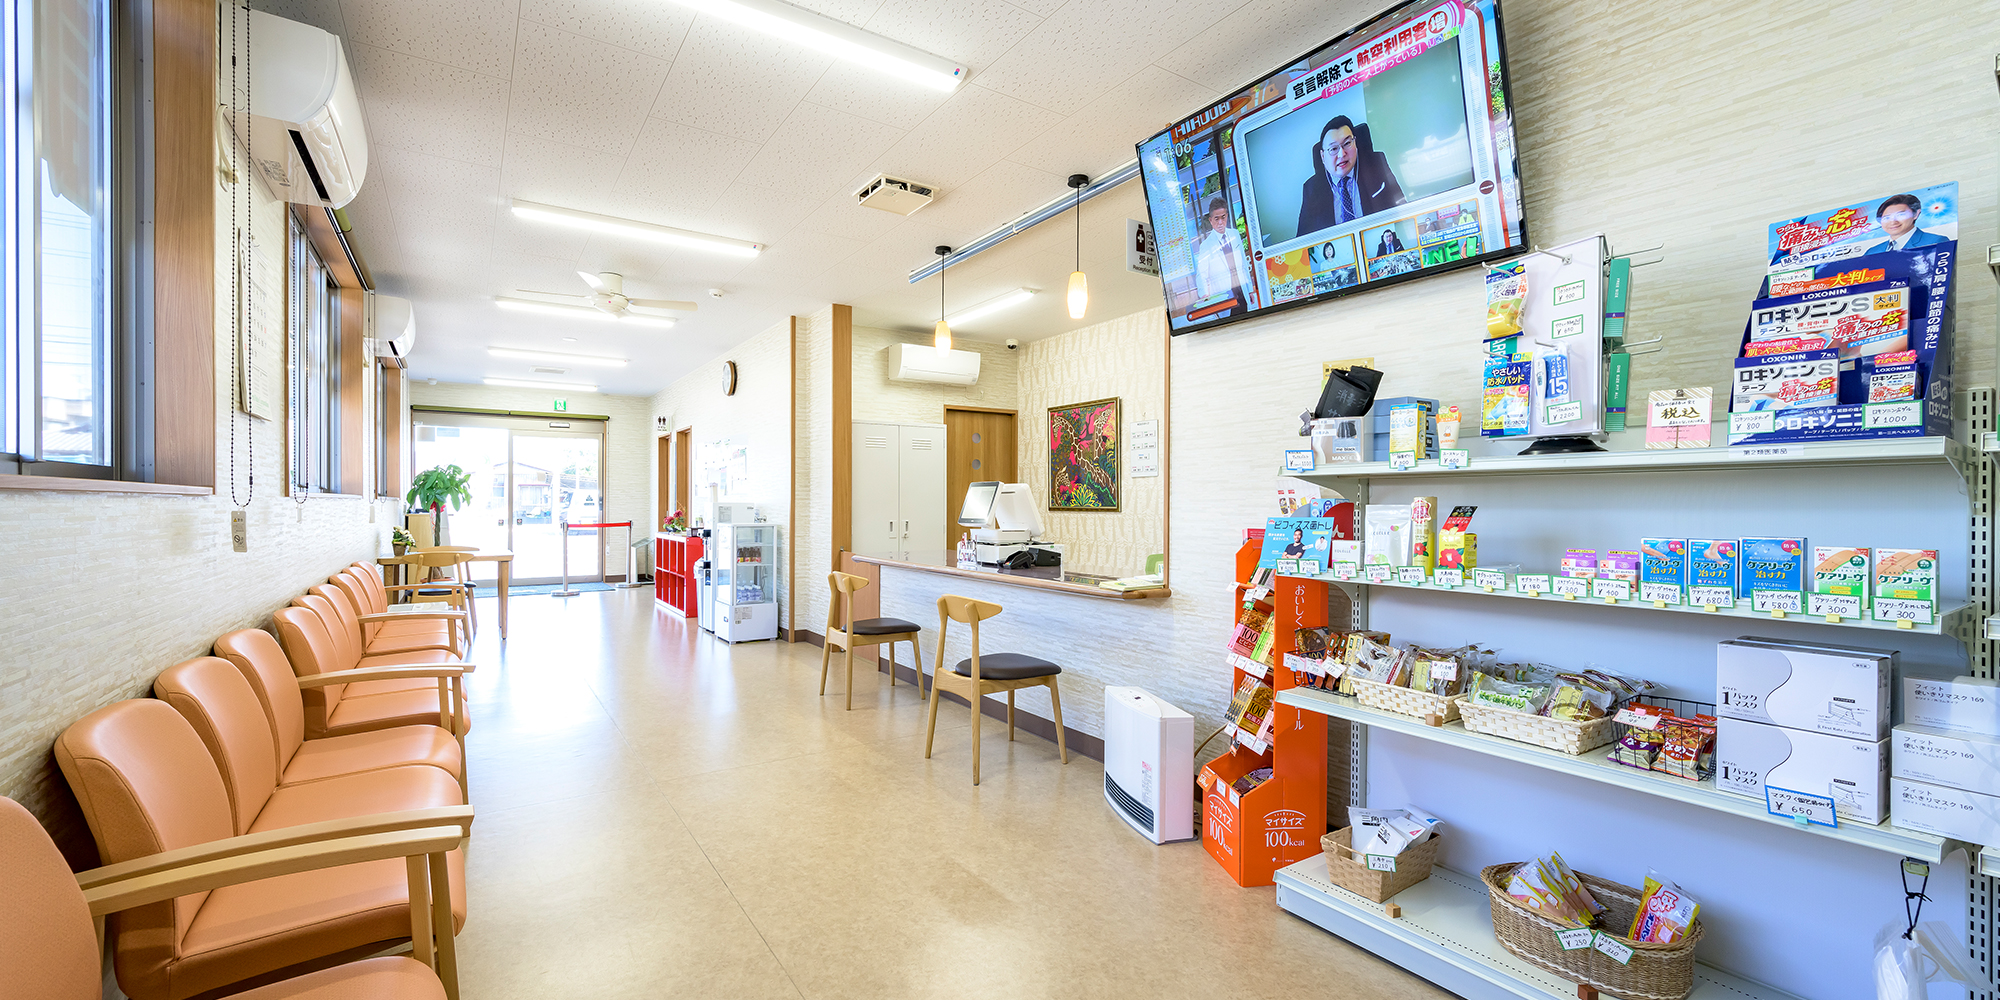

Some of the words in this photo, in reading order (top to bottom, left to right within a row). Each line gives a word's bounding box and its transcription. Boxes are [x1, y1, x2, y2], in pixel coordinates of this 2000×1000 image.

[1292, 57, 1354, 100] 宣言解除で
[1357, 20, 1428, 68] 航空利用客
[1429, 12, 1447, 32] 増
[1155, 139, 1192, 163] 11:06
[1777, 222, 1799, 233] つらい
[1139, 254, 1153, 266] 受付
[1802, 288, 1848, 300] LOXONIN
[1875, 294, 1899, 305] 大判
[1924, 251, 1951, 350] つらい肩・腰・関節の痛みに
[1761, 354, 1807, 364] LOXONIN
[1492, 366, 1521, 377] やさしい
[1487, 374, 1525, 386] 防水パッド
[1742, 384, 1767, 392] テープ
[1660, 407, 1700, 419] 税込
[1645, 559, 1682, 567] ケアリーヴ
[1693, 561, 1733, 570] ケアリーヴ
[1746, 561, 1796, 571] ケアリーヴ
[1650, 567, 1676, 575] 治す力
[1698, 569, 1727, 578] 治す力
[1755, 570, 1786, 579] 治す力
[1816, 571, 1867, 582] ケアリーヴ
[1878, 575, 1934, 585] ケアリーヴ
[1897, 611, 1915, 619] 300
[1242, 628, 1258, 643] 100
[1915, 683, 1943, 691] フィット
[1722, 691, 1730, 705] 1
[1733, 692, 1757, 701] パック
[1914, 690, 1967, 700] 使いきりマスク
[1733, 700, 1757, 709] マスク
[1249, 703, 1265, 718] 100
[1904, 736, 1933, 745] フィット
[1903, 743, 1957, 756] 使いきりマスク
[1722, 765, 1731, 780] 1
[1733, 766, 1757, 778] パック
[1733, 774, 1757, 786] マスク
[1903, 786, 1932, 796] フィット
[1902, 792, 1956, 807] 使いきりマスク
[1960, 803, 1974, 811] 169
[1209, 800, 1232, 828] マイサイズ
[1791, 806, 1812, 816] 650
[1265, 818, 1303, 826] マイサイズ
[1265, 831, 1305, 847] 100kcal
